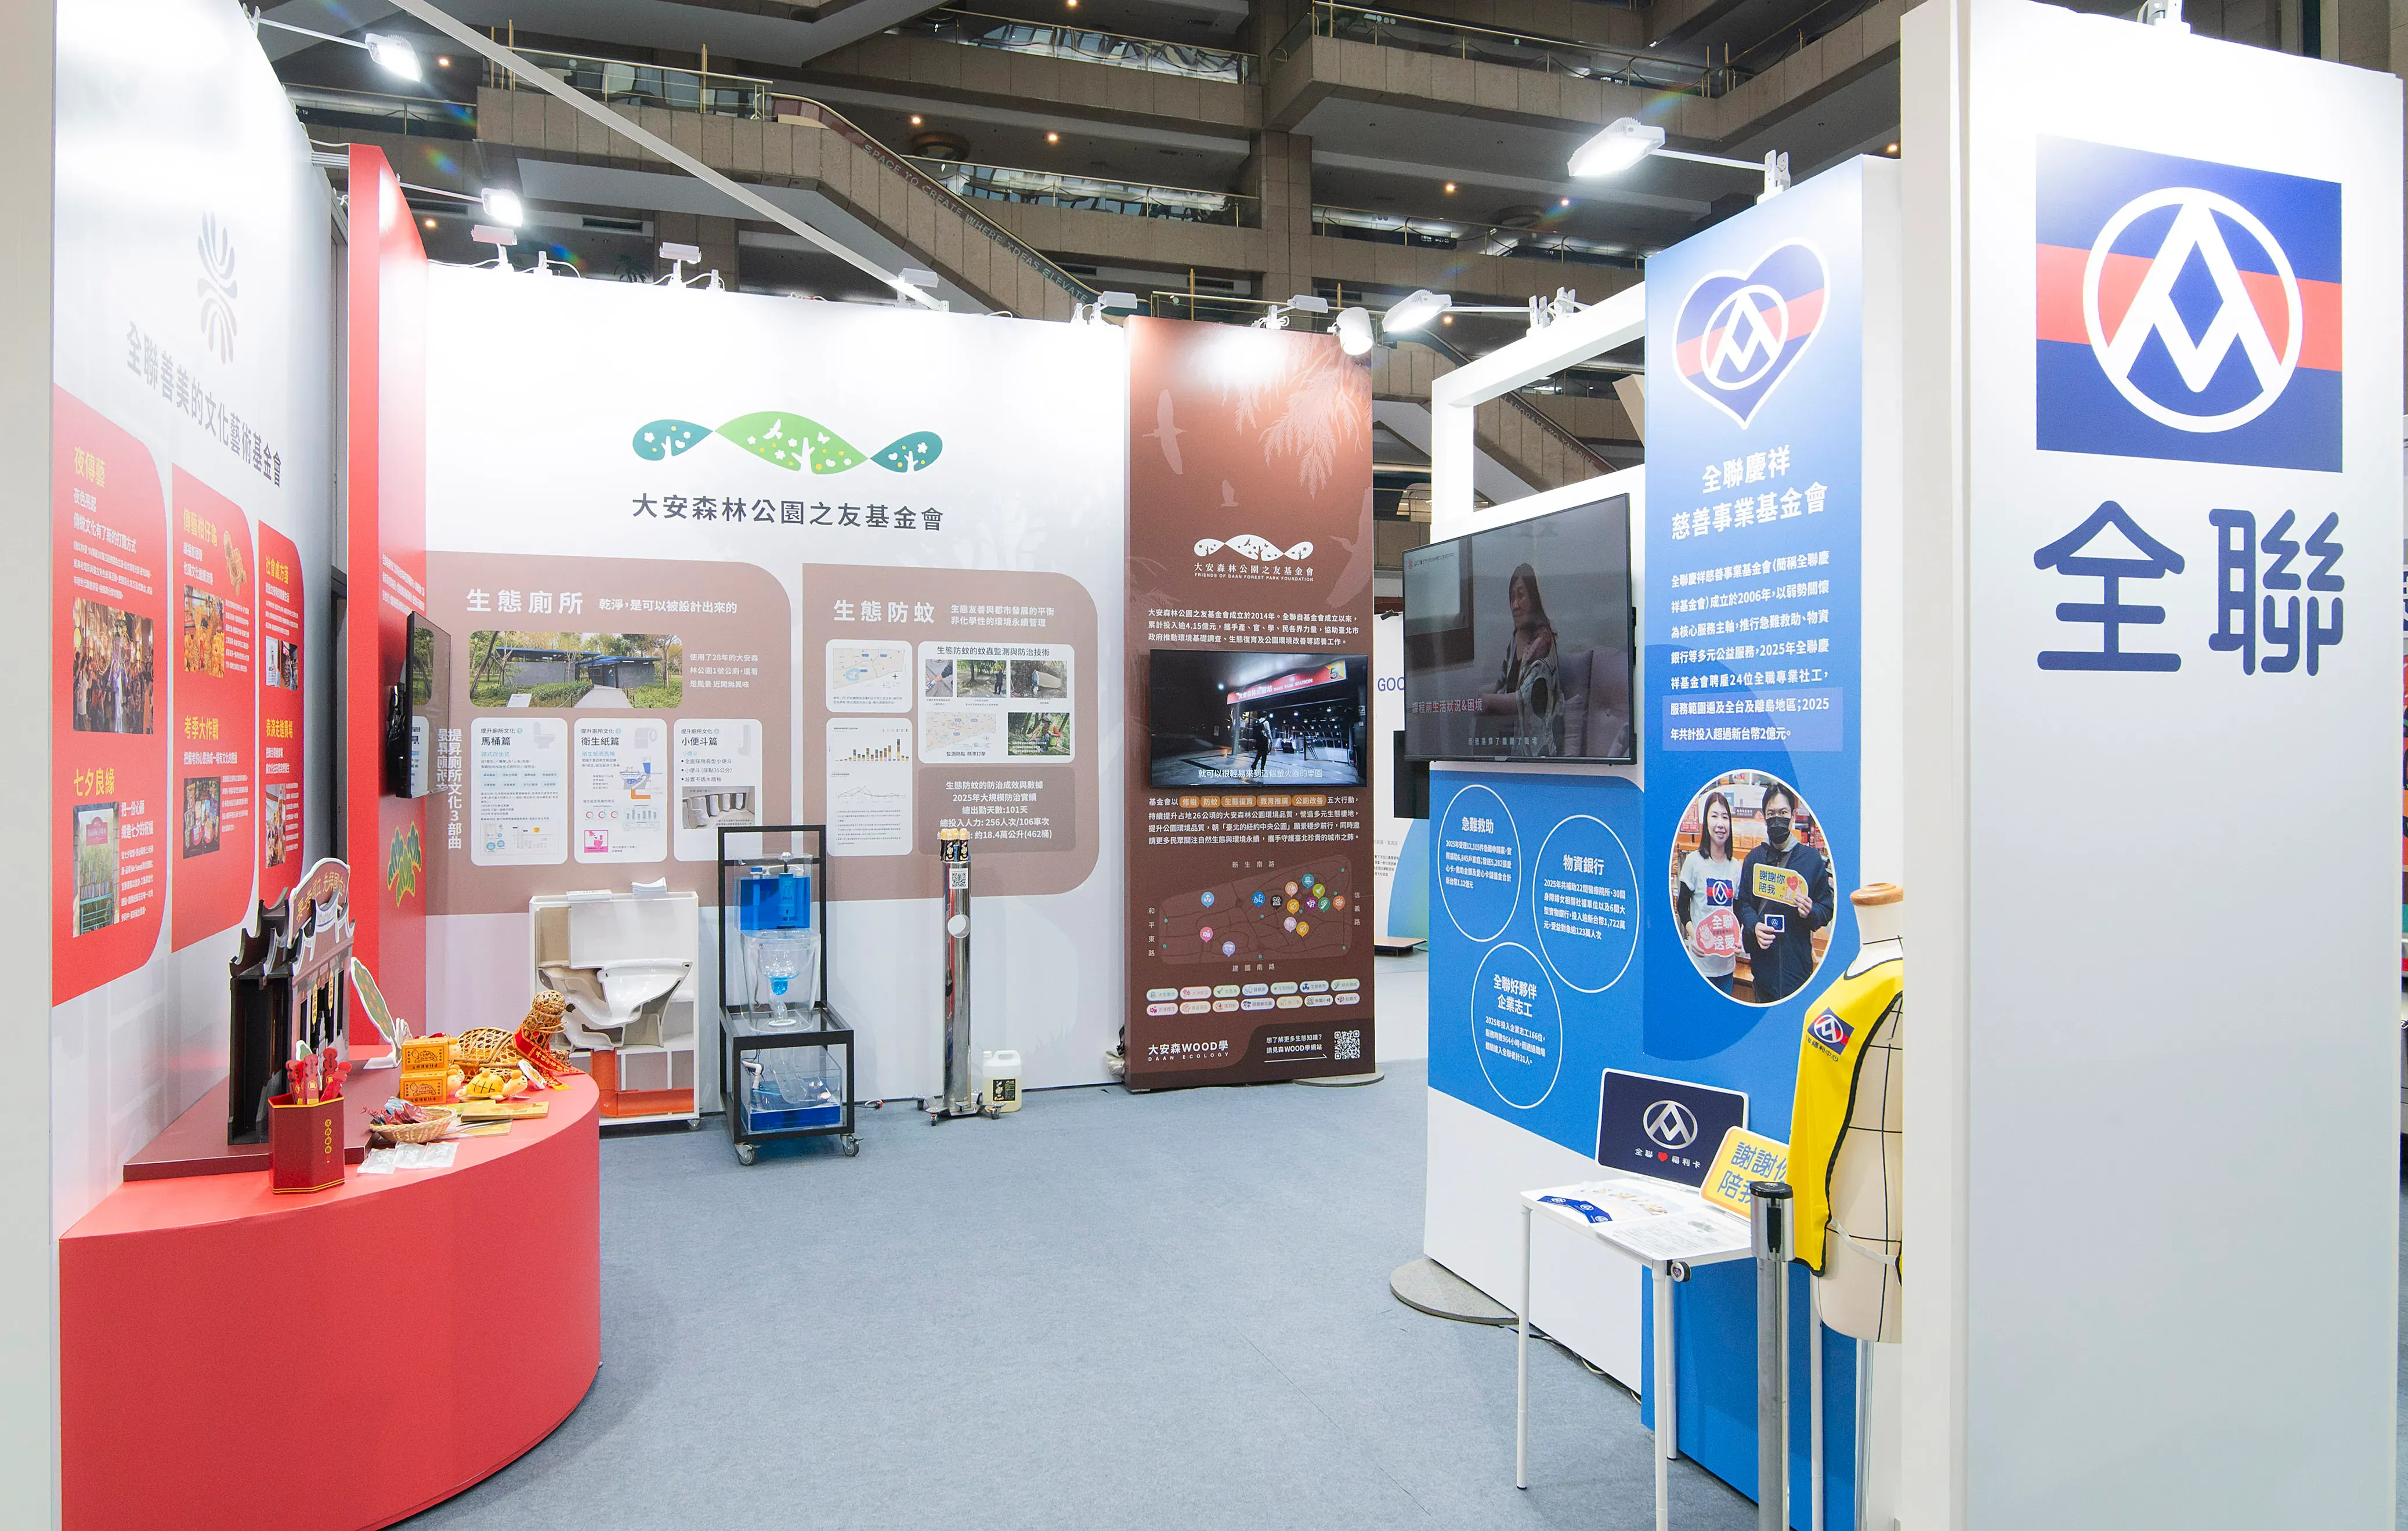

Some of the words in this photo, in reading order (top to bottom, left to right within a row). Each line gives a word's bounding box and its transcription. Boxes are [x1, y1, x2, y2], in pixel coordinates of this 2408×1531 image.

[863, 144, 902, 173] SPACE
[905, 171, 919, 186] TO
[922, 185, 963, 215] CREATE
[965, 214, 1003, 244] WHERE
[1006, 241, 1040, 270] IDEAS
[1042, 268, 1088, 303] ELEVATE
[126, 321, 281, 487] 全聯善美的文化藝術基金會
[74, 446, 105, 488] 夜傳藝
[1702, 444, 1791, 494] 全聯慶祥
[632, 493, 943, 532] 大安森林公園之友基金會
[1672, 482, 1828, 541] 慈善事業基金會
[1194, 562, 1314, 576] 大安森林公園之友基金會
[2034, 501, 2345, 676] 全聯
[467, 588, 583, 615] 生態廁所
[599, 598, 737, 614] 乾淨,是可以被設計出來的
[833, 600, 935, 623] 生態防蚊
[951, 605, 1054, 617] 生態友善與都市發展的平衡
[951, 616, 1046, 627] 非化學性的環境永續管理
[689, 653, 758, 663] 使用了28年的大安森
[937, 646, 1050, 657] 生態防蚊的蚊蟲監測與防治技術
[1329, 668, 1339, 680] 5
[1295, 678, 1313, 687] STATION
[481, 736, 511, 746] 馬桶篇
[581, 737, 619, 746] 衛生紙篇
[681, 737, 717, 746] 小便斗篇
[74, 768, 115, 797] 七夕良緣
[448, 729, 462, 849] 提昇廁所文化3部曲
[946, 780, 1043, 790] 生態防蚊的防治成效與數據
[953, 793, 1037, 802] 2025年大規模防治實績
[1149, 798, 1178, 806] 基金會以
[1462, 816, 1494, 834] 急難救助
[1232, 860, 1275, 868] 新生南路
[1563, 854, 1604, 876] 物資銀行
[1760, 870, 1785, 884] 謝謝你
[1759, 882, 1775, 895] 陪我
[1494, 973, 1537, 1000] 全聯好夥伴
[1498, 994, 1532, 1018] 企業志工
[1148, 1040, 1228, 1055] 大安森WOOD學
[1183, 1052, 1229, 1060] ECOLOGY
[1635, 1148, 1653, 1159] 全聯
[1672, 1155, 1701, 1168] 福利卡
